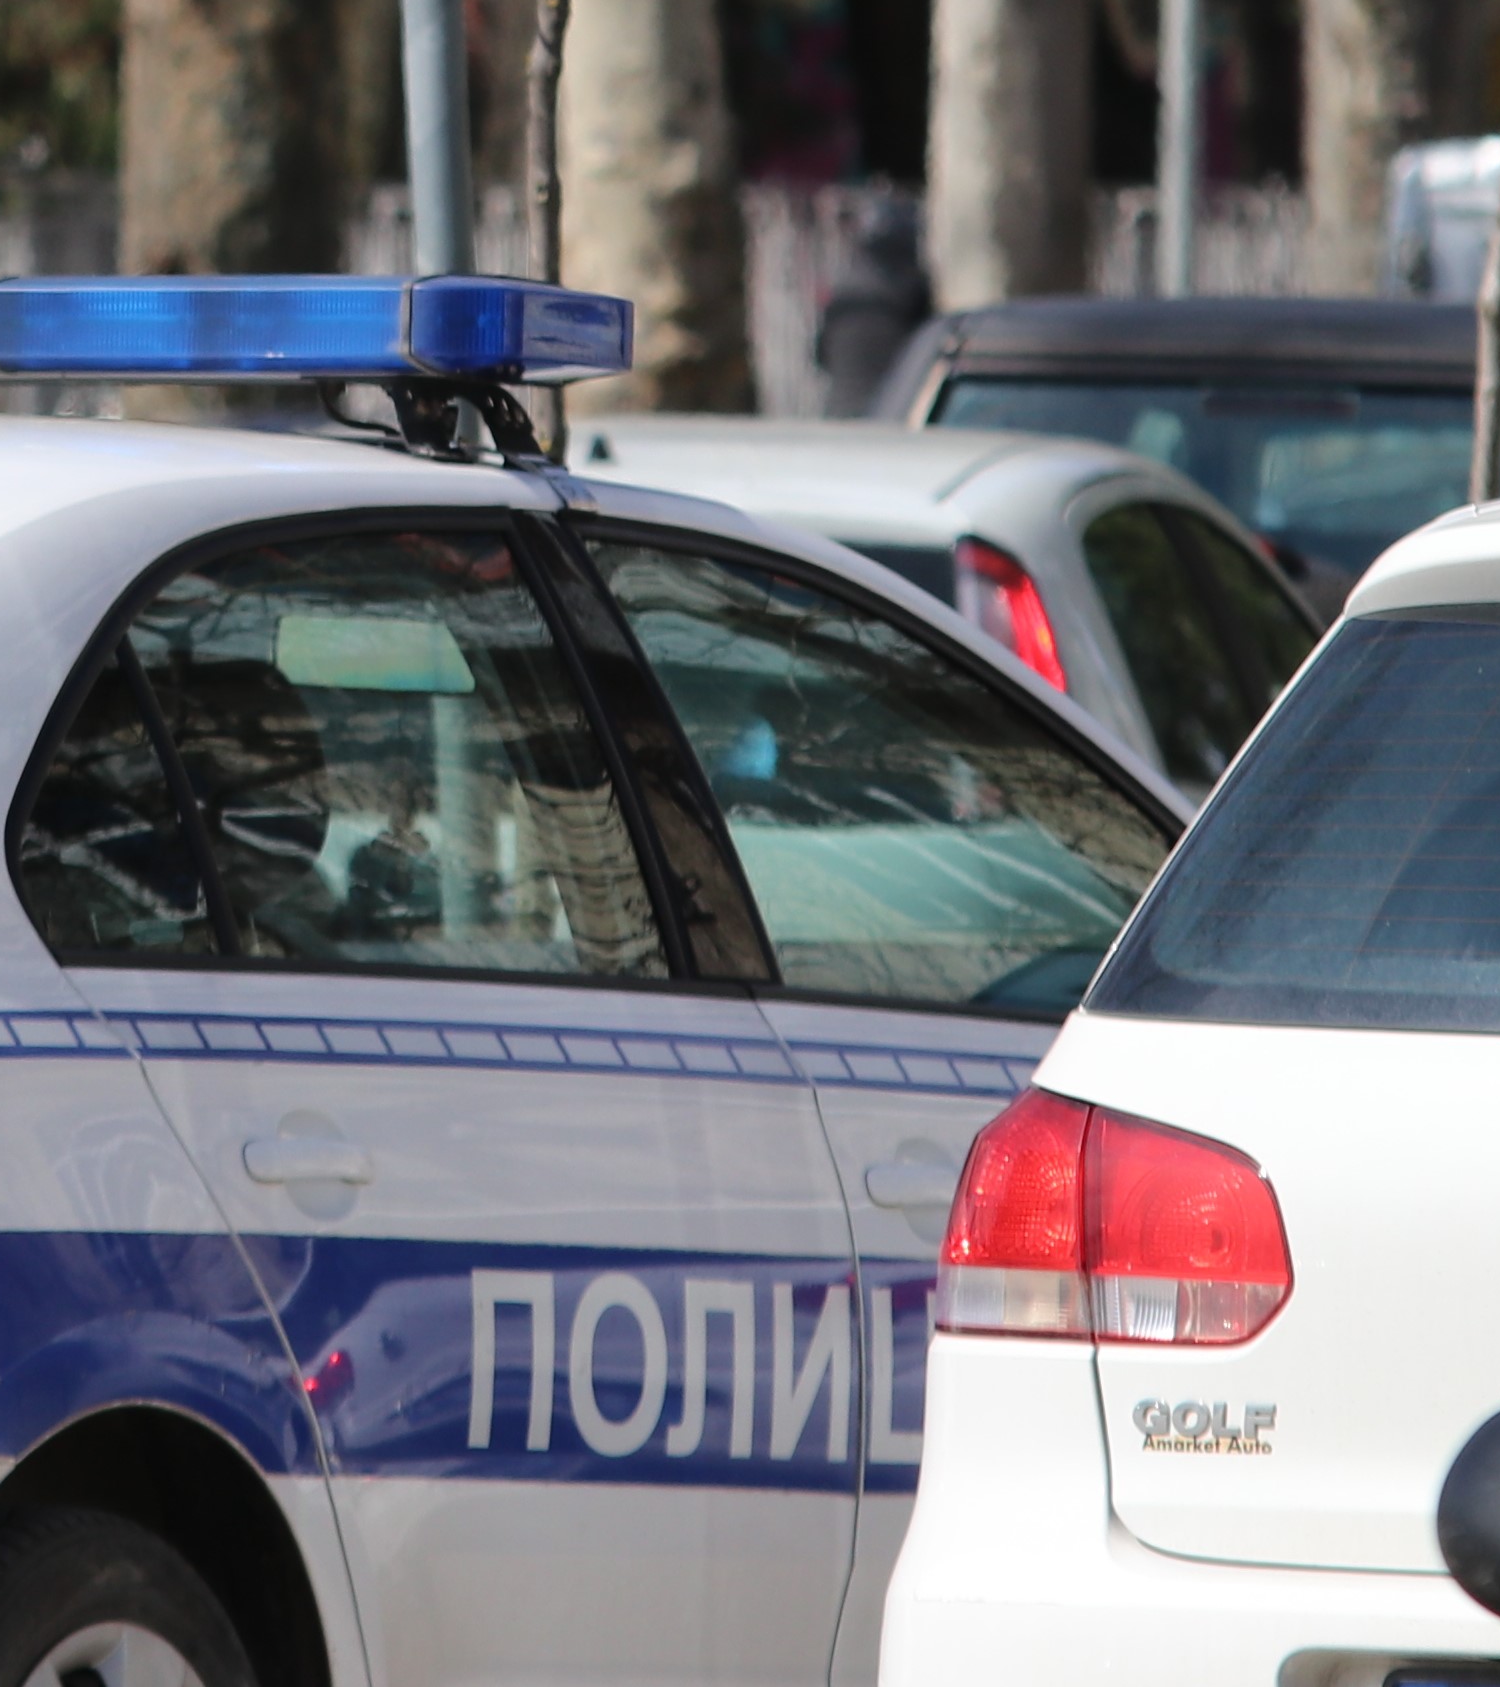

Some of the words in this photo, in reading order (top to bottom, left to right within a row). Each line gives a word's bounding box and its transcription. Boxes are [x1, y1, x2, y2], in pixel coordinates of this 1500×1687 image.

[1131, 1396, 1278, 1439] GOLF
[1142, 1433, 1222, 1454] Amarket
[1226, 1434, 1273, 1456] Auto
